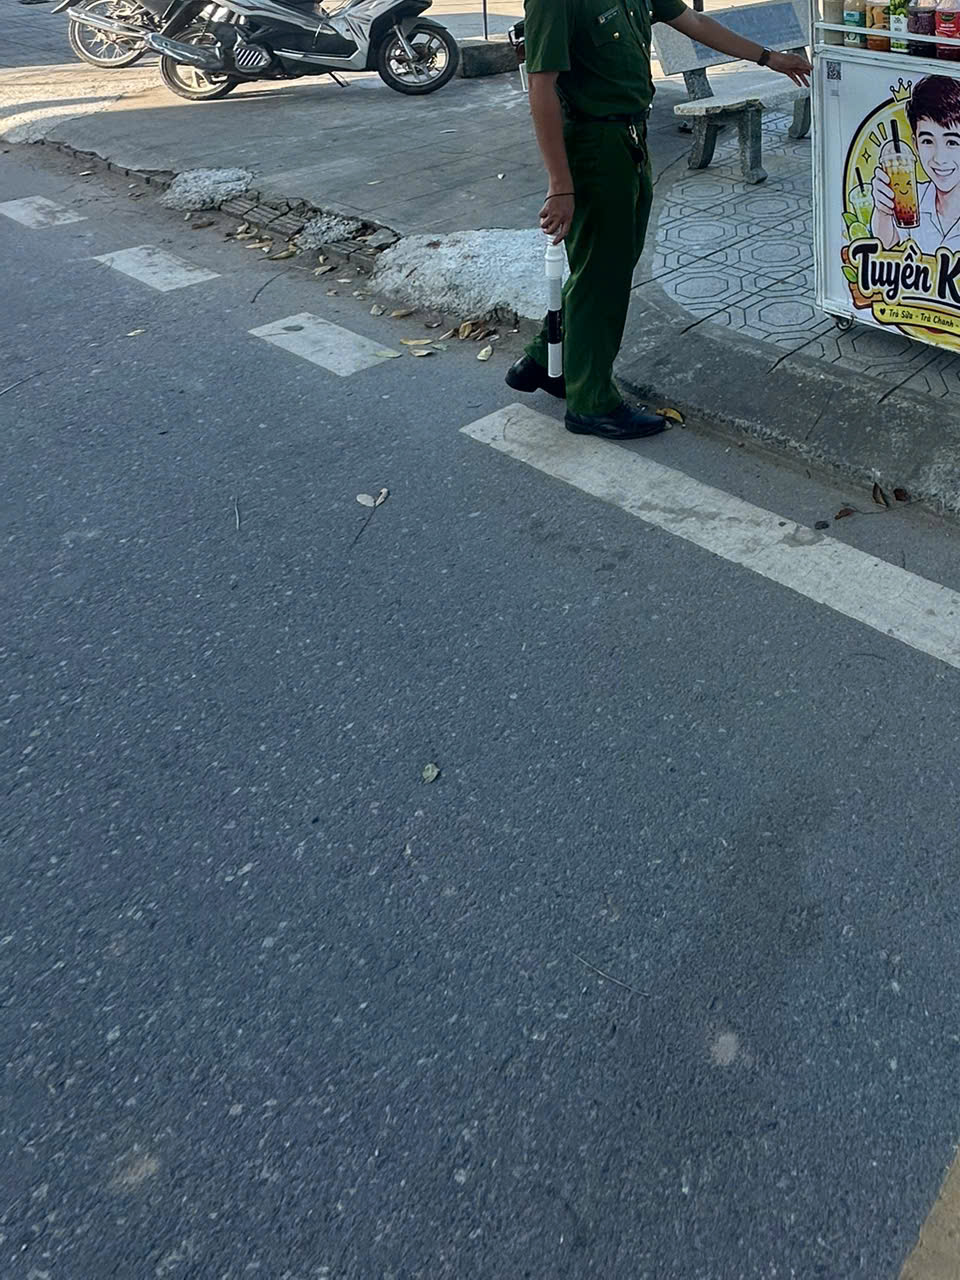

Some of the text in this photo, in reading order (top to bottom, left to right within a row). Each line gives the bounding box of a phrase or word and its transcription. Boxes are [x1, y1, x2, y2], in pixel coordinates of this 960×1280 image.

[852, 243, 932, 301] Tuyền
[889, 308, 899, 318] Trà
[920, 312, 931, 323] Trà
[933, 315, 954, 328] Chanh
